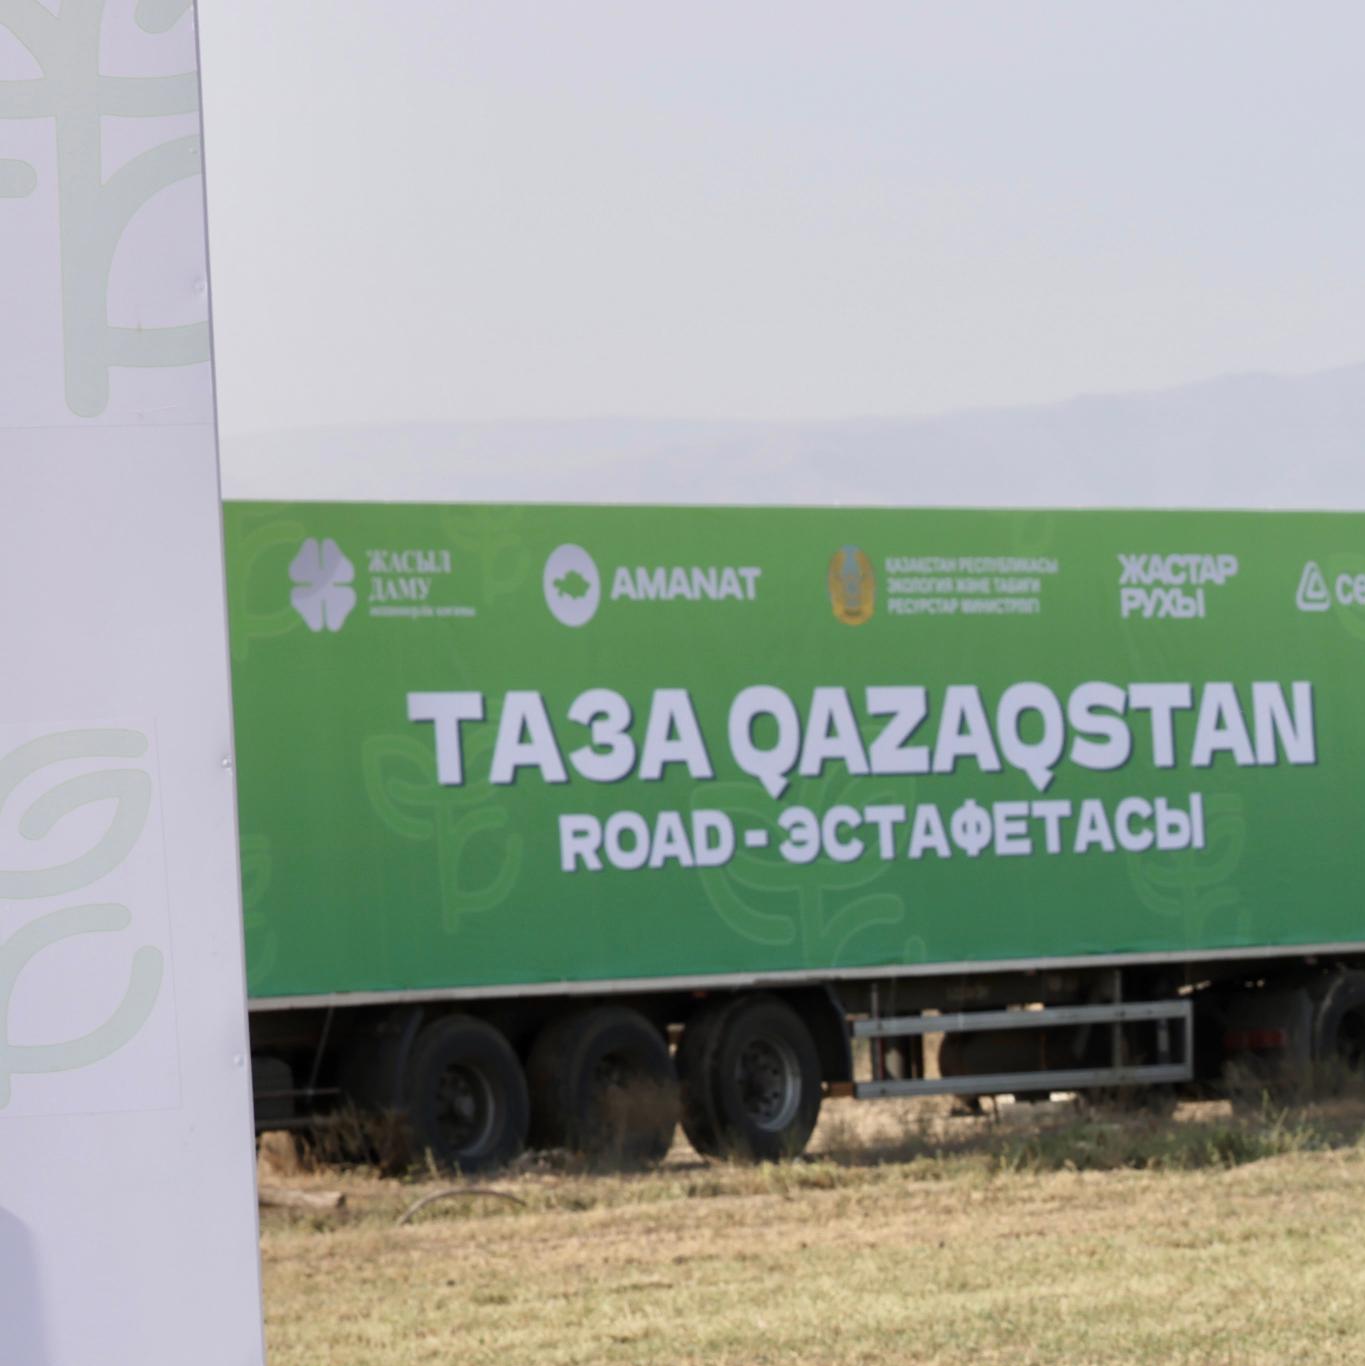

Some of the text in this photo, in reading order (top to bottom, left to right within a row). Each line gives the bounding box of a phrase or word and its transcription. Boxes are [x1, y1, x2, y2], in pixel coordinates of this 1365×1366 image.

[366, 550, 452, 573] ЖАСЫЛ
[1117, 553, 1238, 585] ЖАСТАР
[368, 577, 432, 602] ДАМУ
[611, 566, 762, 600] AMANAT
[1121, 587, 1206, 619] РУХЫ
[406, 681, 1317, 800] ТАЗА QAZAQSTAN
